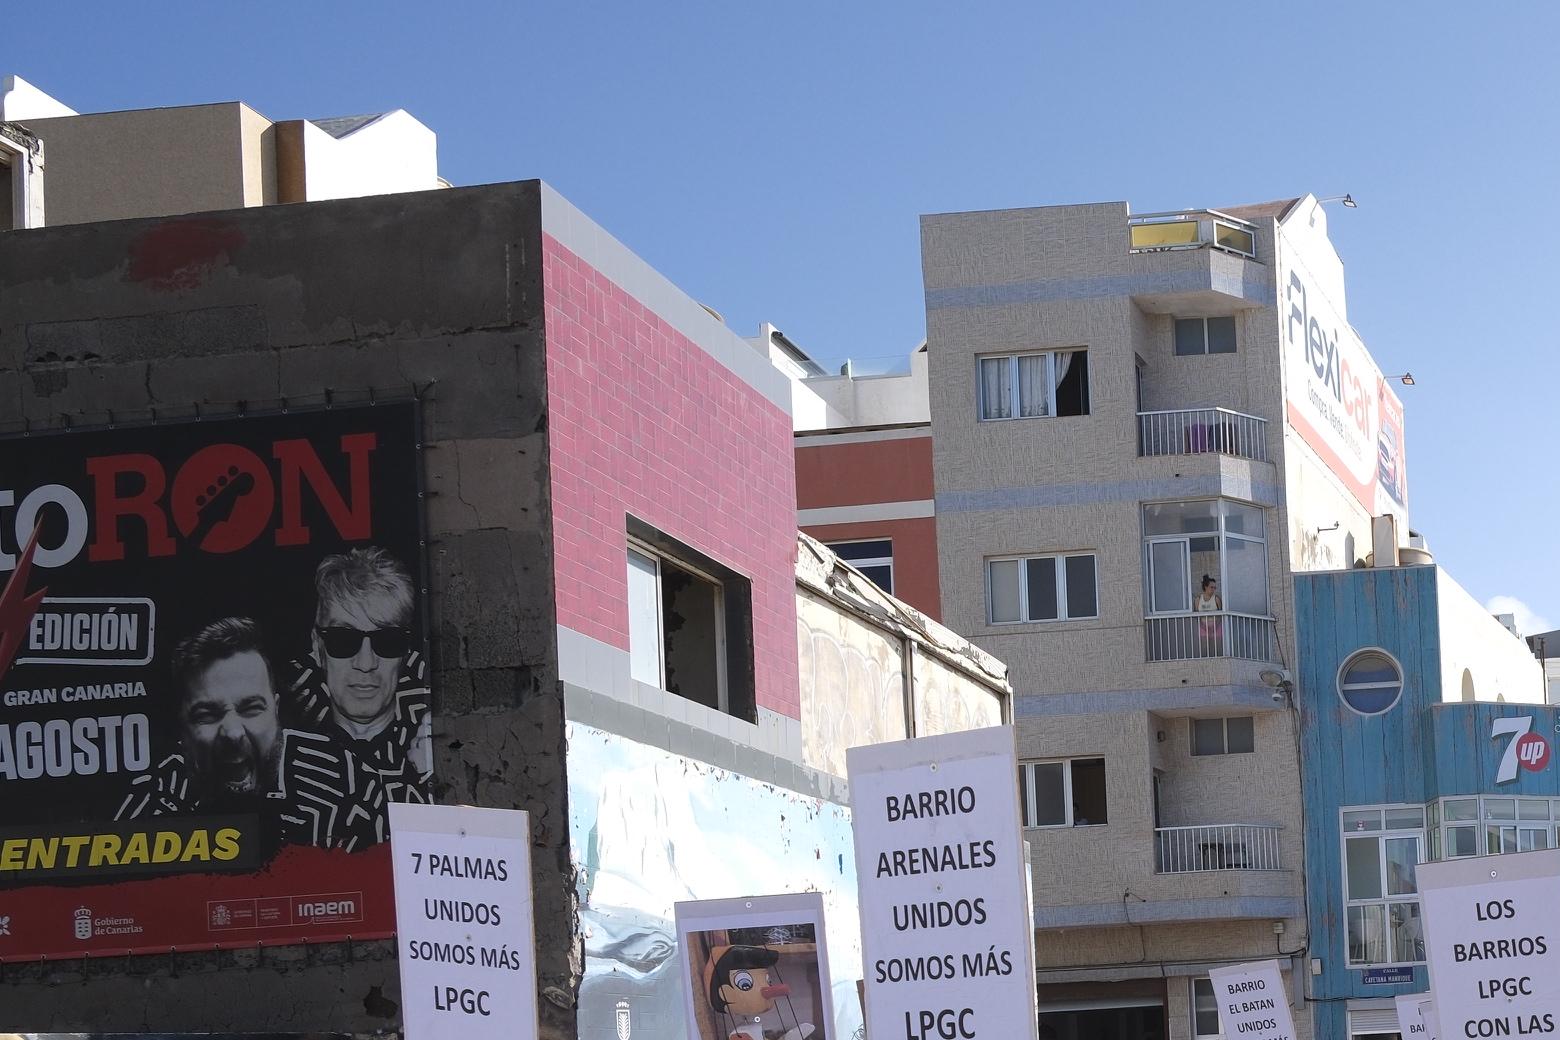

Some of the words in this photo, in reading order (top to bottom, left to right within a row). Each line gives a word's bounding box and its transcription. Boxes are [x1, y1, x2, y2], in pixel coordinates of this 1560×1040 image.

[29, 607, 138, 651] EDICIÓN
[4, 688, 57, 706] GRAN
[61, 682, 147, 702] CANARIA
[886, 786, 975, 822] BARRIO
[0, 828, 242, 871] ENTRADAS
[877, 840, 996, 878] ARENALES
[411, 853, 422, 874] 7
[429, 854, 507, 881] PALMAS
[94, 916, 134, 926] Gobierno
[299, 900, 355, 917] inaem
[425, 898, 500, 926] UNIDOS
[893, 898, 986, 931] UNIDOS
[1476, 899, 1515, 921] LOS
[410, 940, 475, 965] SOMOS
[481, 944, 520, 970] MÁS
[1454, 936, 1547, 962] BARRIOS
[875, 955, 955, 983] SOMOS
[962, 945, 1012, 978] MÁS
[434, 986, 490, 1016] LPGC
[1228, 980, 1265, 994] BARRIO
[1478, 976, 1532, 999] LPGC
[1229, 1004, 1241, 1014] EL
[1242, 999, 1274, 1012] BATAN
[905, 1008, 975, 1040] LPGC
[1237, 1018, 1276, 1035] UNIDOS
[1465, 1017, 1510, 1038] CON
[1517, 1014, 1554, 1034] LAS
